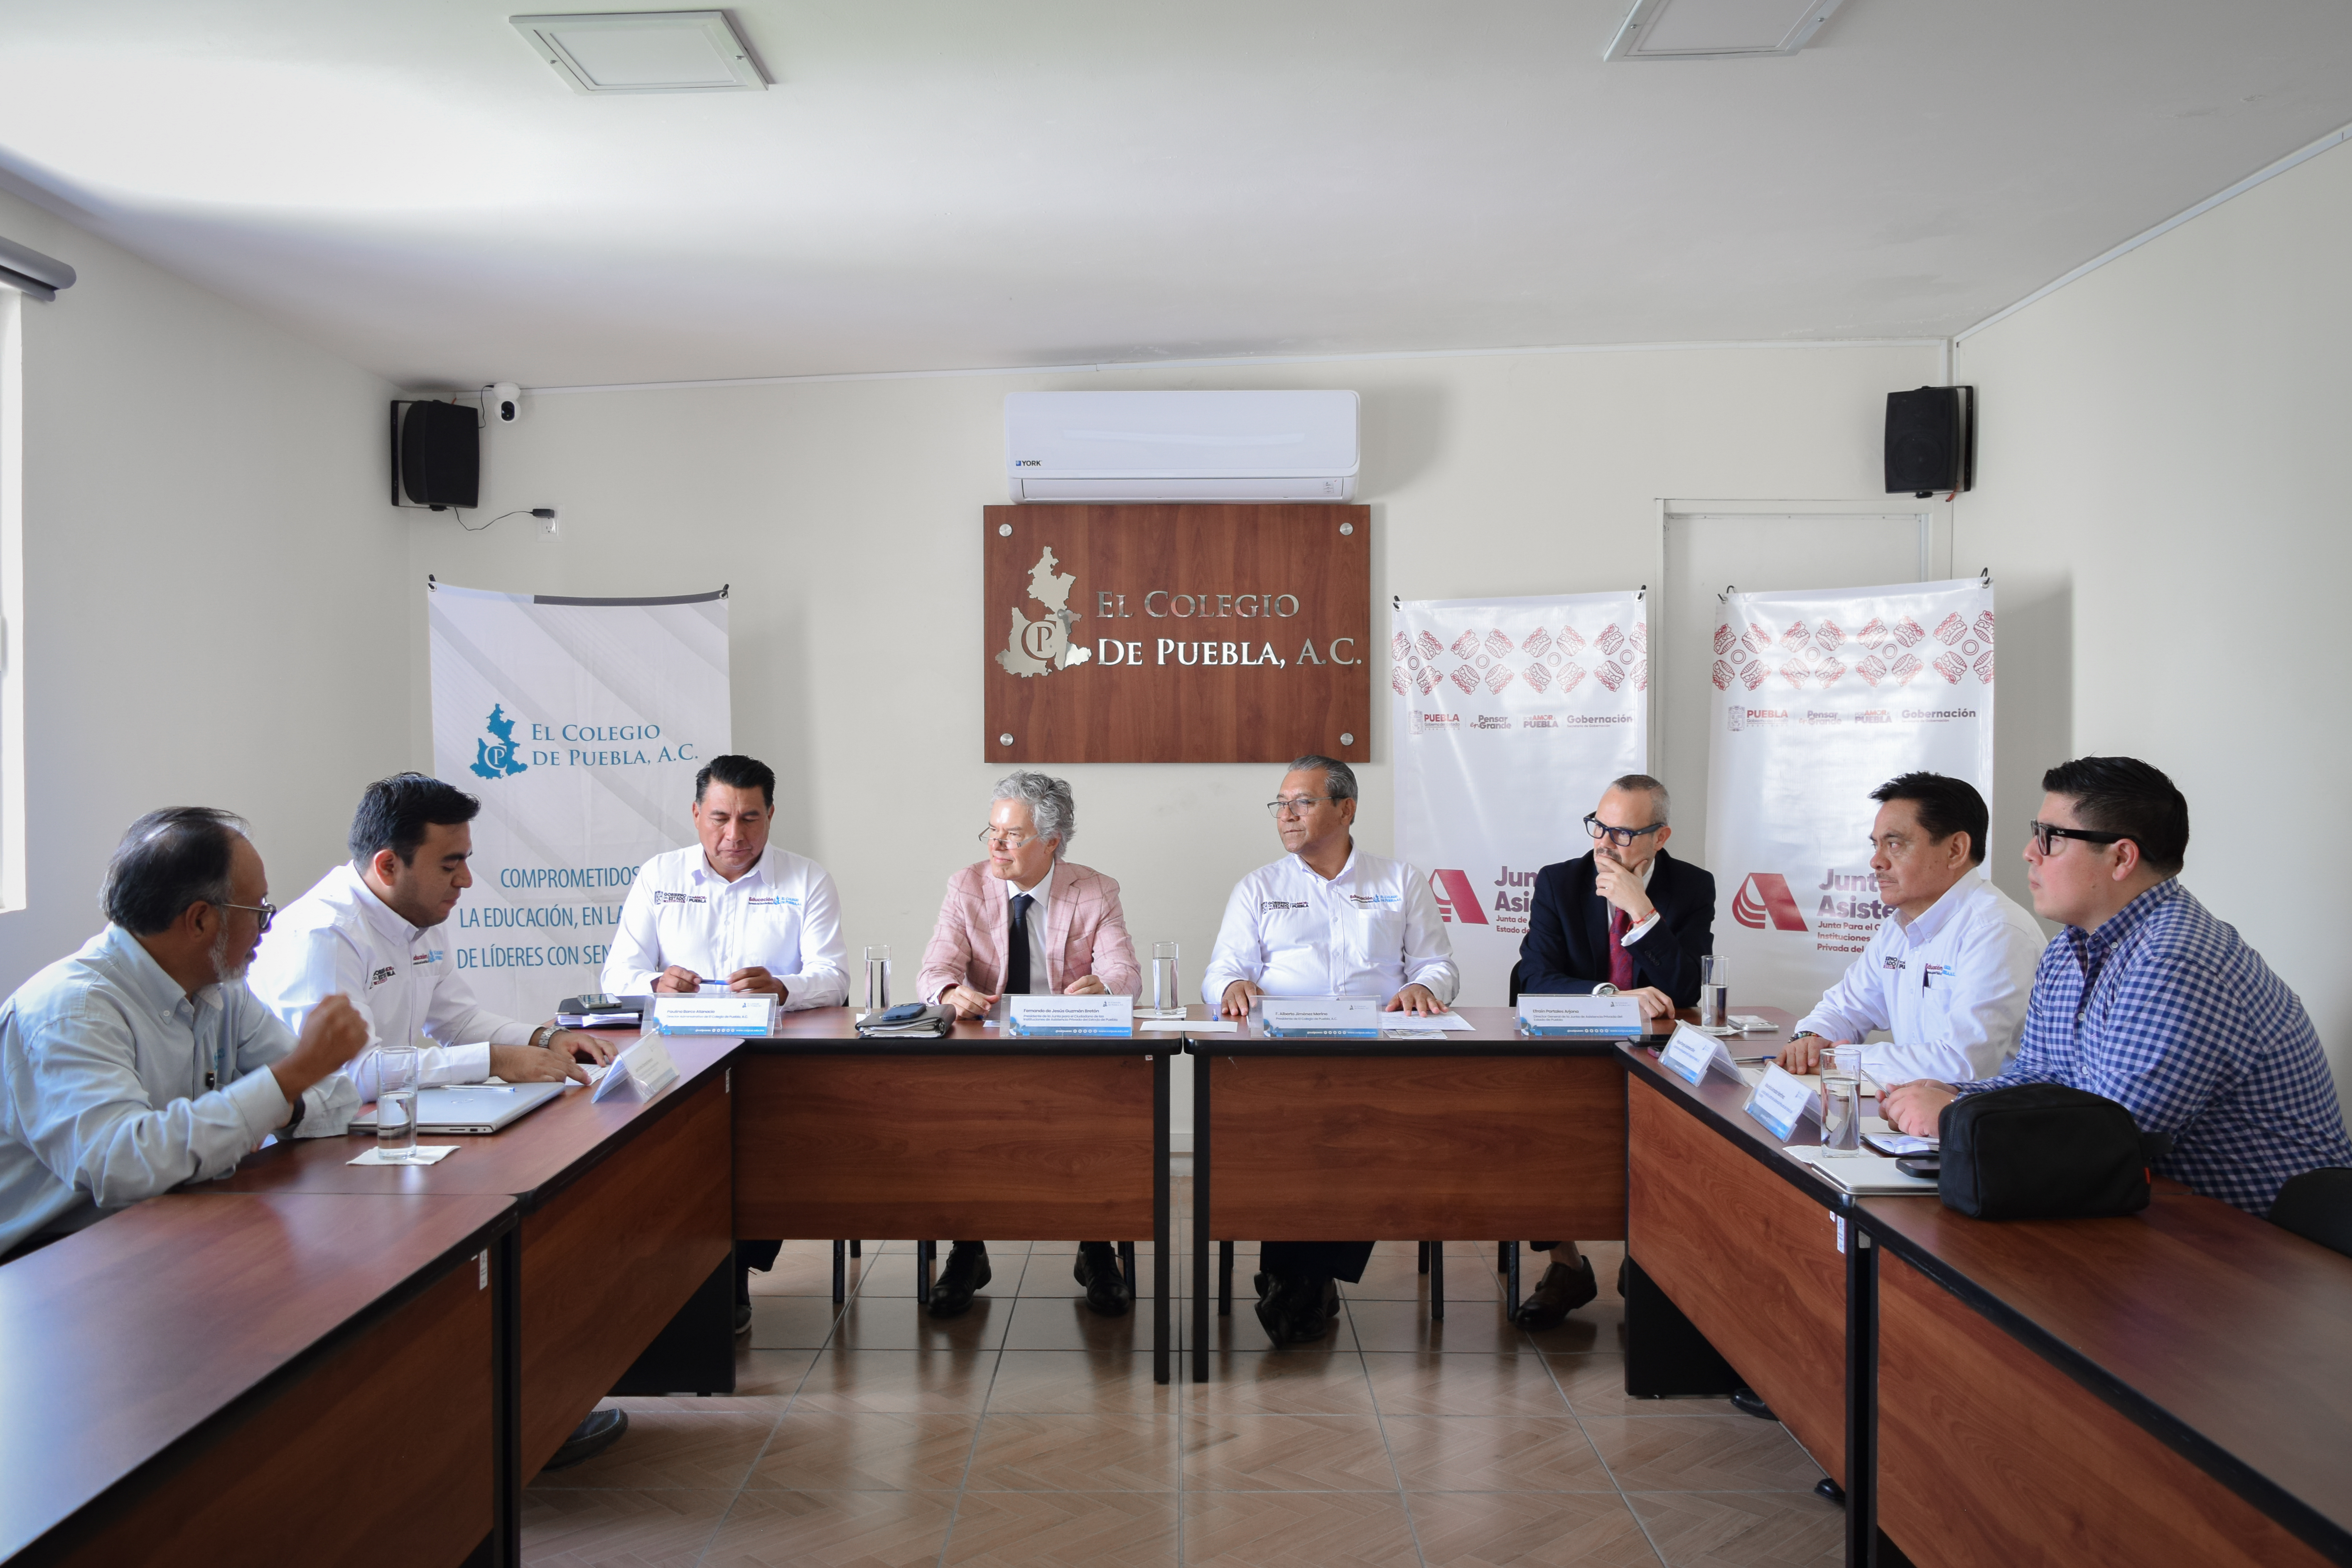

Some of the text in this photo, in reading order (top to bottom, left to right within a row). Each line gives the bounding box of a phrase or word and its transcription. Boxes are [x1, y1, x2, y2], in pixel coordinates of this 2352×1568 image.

[1097, 590, 1300, 618] EL COLEGIO
[1097, 638, 1362, 670] DE PUEBLA, A.C.
[1424, 714, 1460, 722] PUEBLA
[1567, 714, 1633, 724] Gobernación
[1747, 710, 1788, 718] PUEBLA
[1807, 710, 1838, 719] Pensar
[1902, 708, 1976, 719] Gobernación
[531, 723, 660, 741] EL COLEGIO
[532, 744, 698, 766] DE PUEBLA, A.C.
[1494, 866, 1538, 887] Jun
[1818, 869, 1878, 892] Junt
[1816, 895, 1897, 920] Asiste
[460, 908, 480, 928] LA
[484, 904, 578, 930] EDUCACIÓN,
[582, 906, 602, 926] EN
[1496, 915, 1516, 923] Junta
[1496, 925, 1520, 934] Estado
[1817, 932, 1871, 942] Instituciones
[1817, 943, 1849, 952] Privada
[457, 948, 478, 969] DE
[482, 944, 544, 967] LÍDERES
[547, 946, 579, 966] CON
[583, 944, 612, 964] SEN
